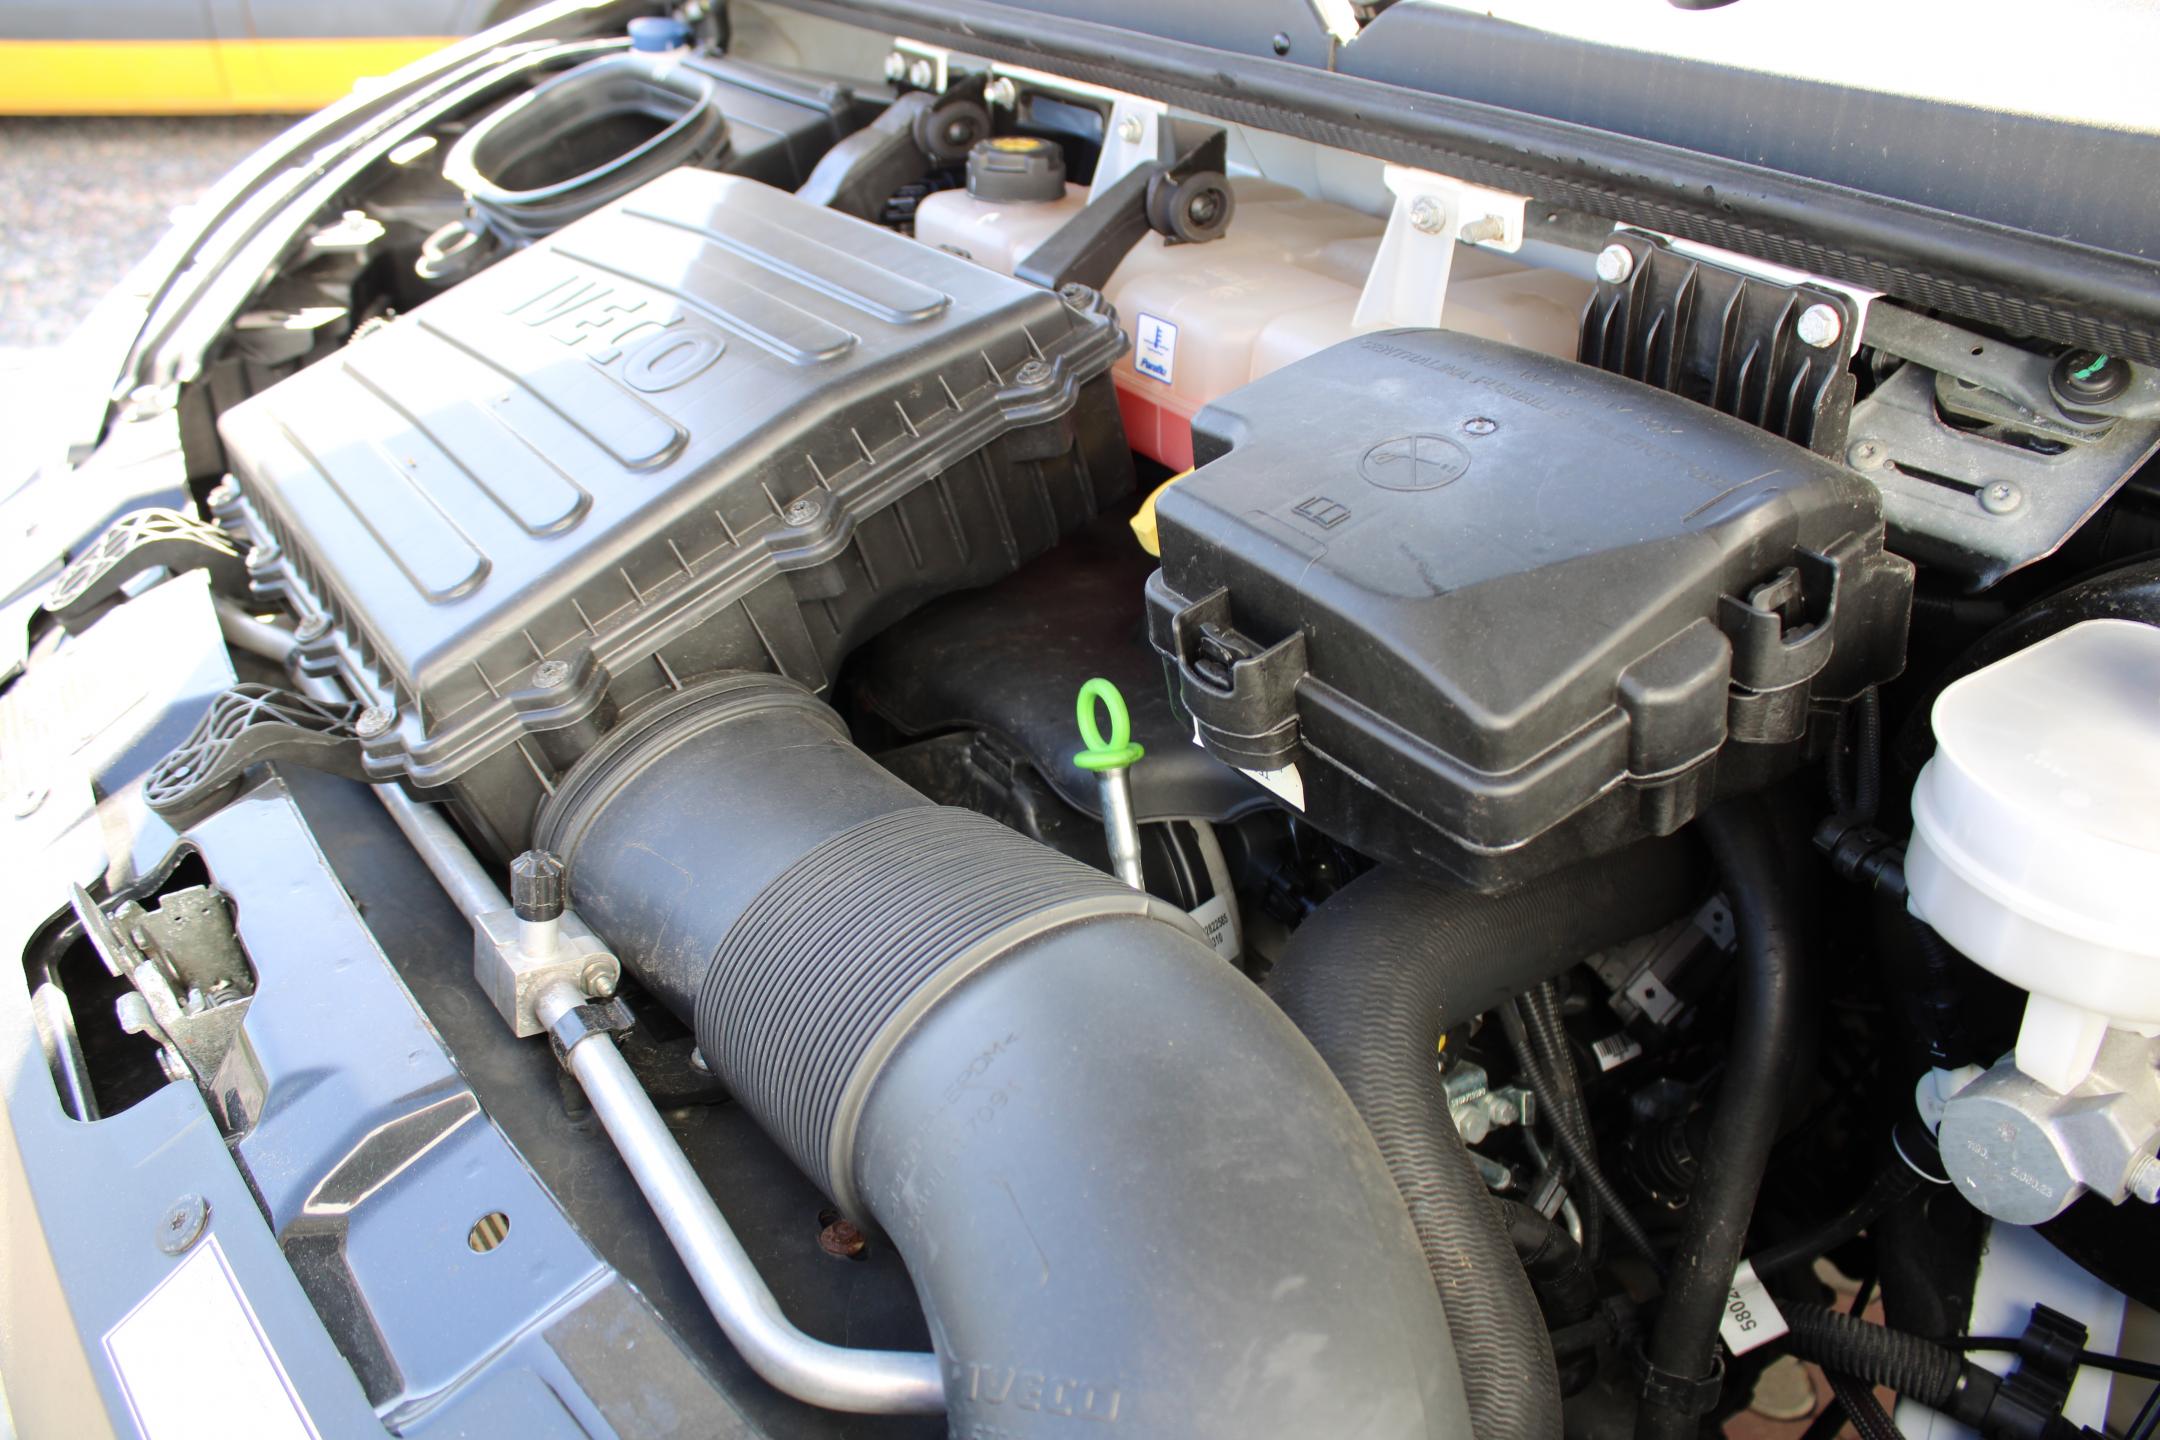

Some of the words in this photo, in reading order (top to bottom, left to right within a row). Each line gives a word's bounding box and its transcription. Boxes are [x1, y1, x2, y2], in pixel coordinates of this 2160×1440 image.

[502, 275, 727, 394] IVECO
[1728, 1287, 1758, 1333] 5802
[967, 1363, 1121, 1423] IVECO
